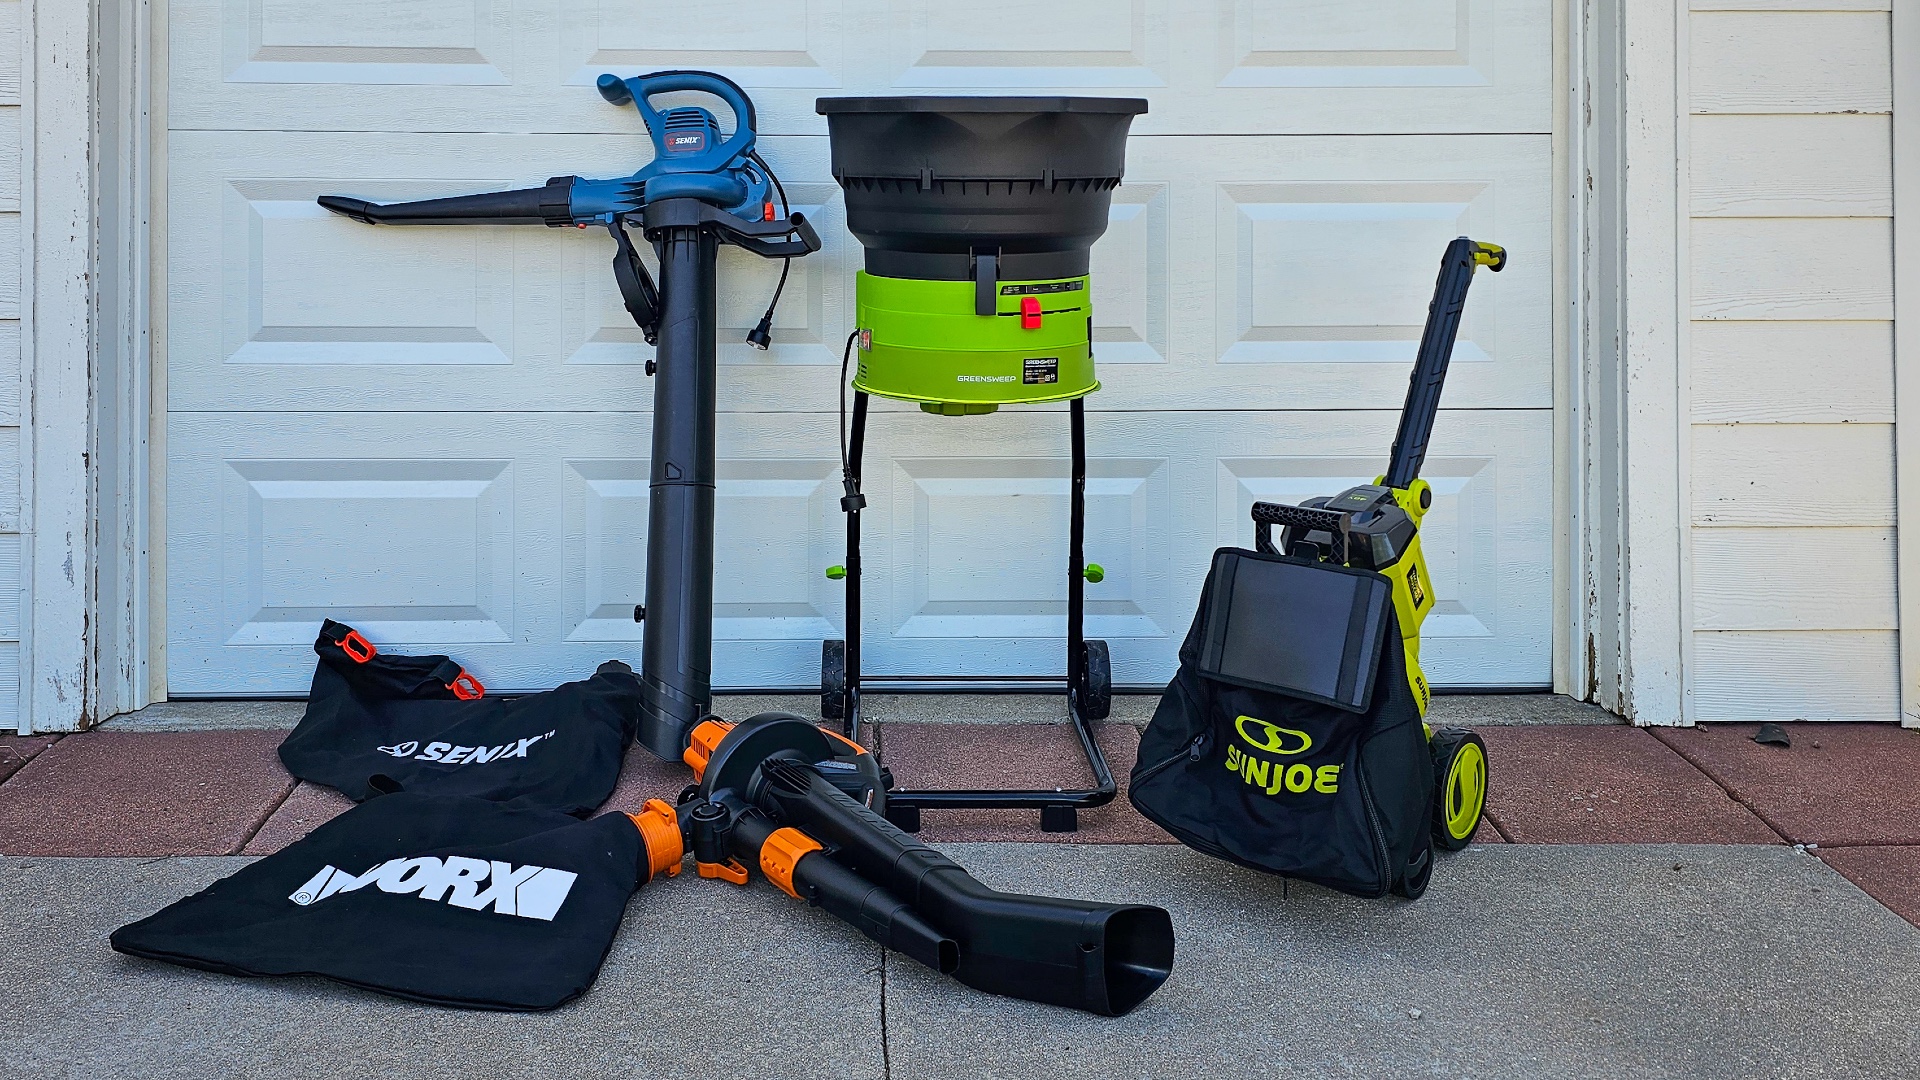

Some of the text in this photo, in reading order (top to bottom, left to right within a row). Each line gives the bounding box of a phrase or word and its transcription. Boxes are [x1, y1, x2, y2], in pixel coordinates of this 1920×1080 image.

[675, 136, 698, 145] SENIX
[957, 375, 1017, 383] GREENSWEEP
[414, 735, 544, 765] SENIX
[1224, 743, 1340, 796] SUNJOE
[288, 855, 578, 922] WORX
